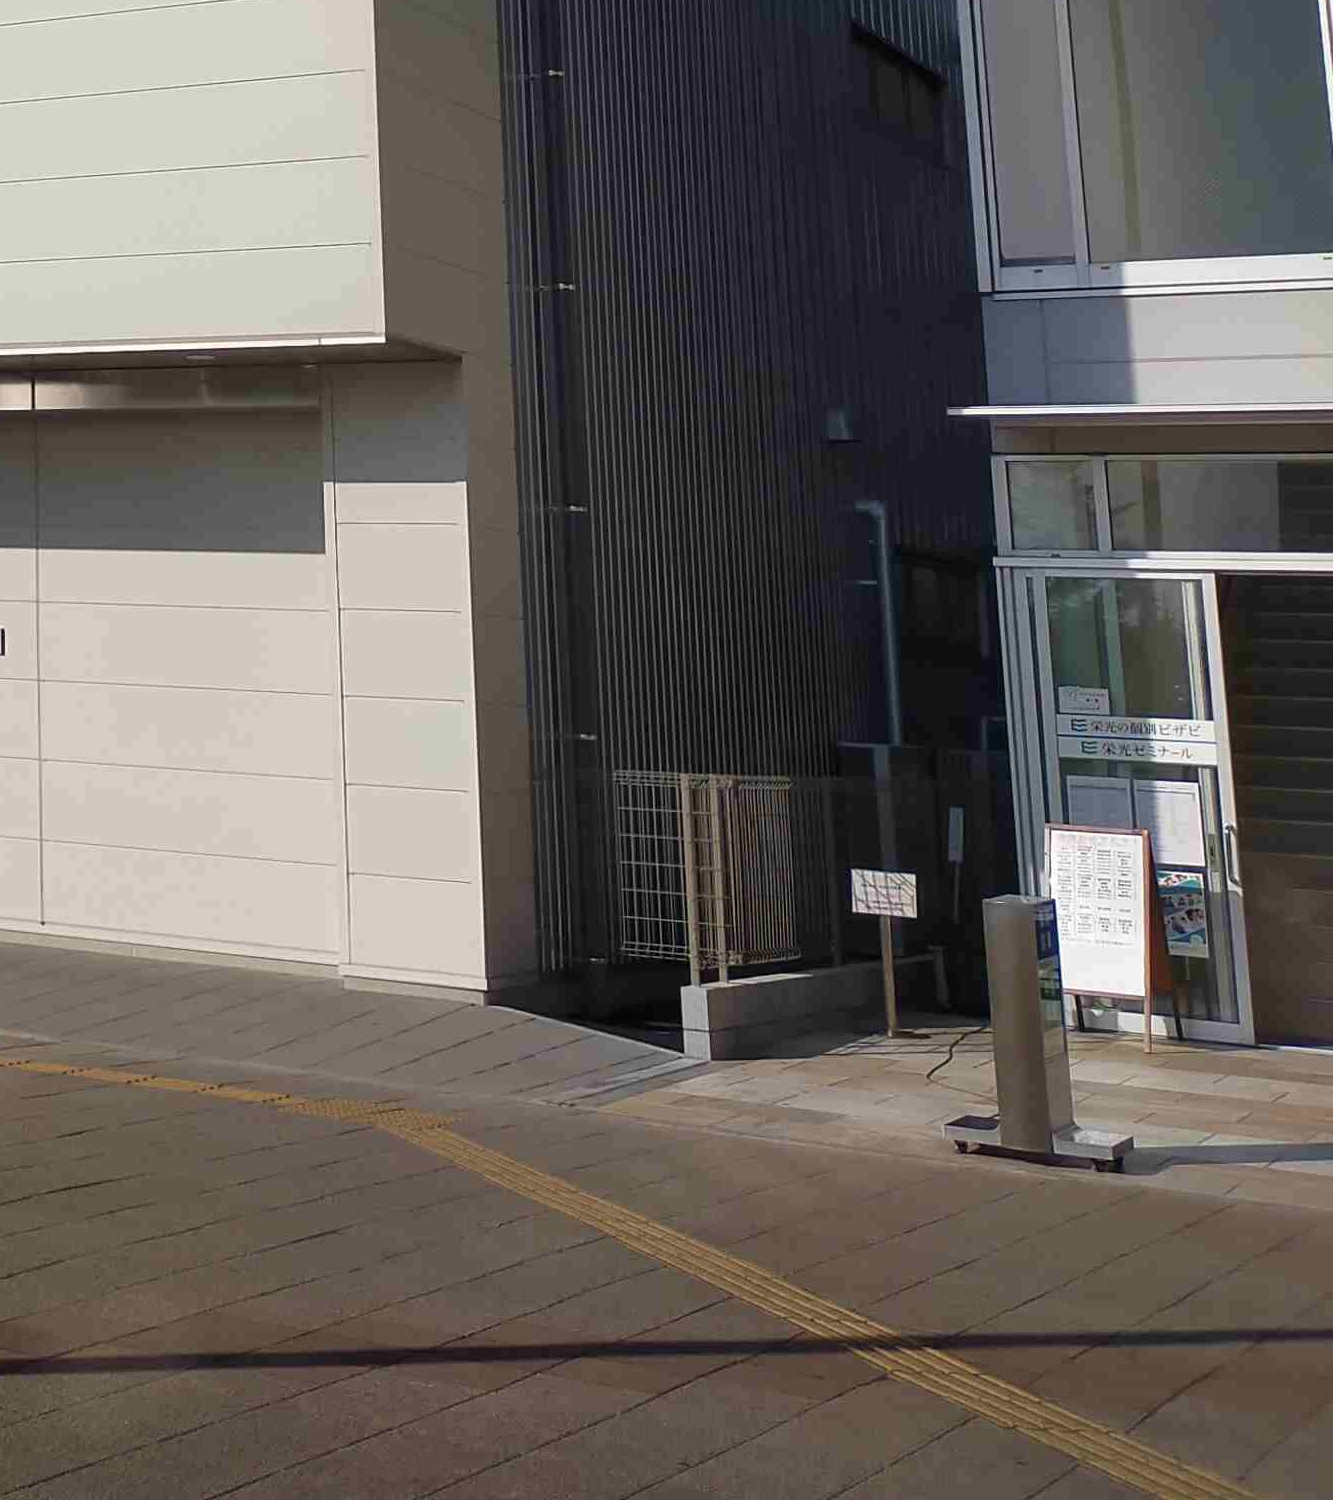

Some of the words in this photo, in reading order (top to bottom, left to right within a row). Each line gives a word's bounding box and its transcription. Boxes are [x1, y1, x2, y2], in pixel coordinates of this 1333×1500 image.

[1101, 740, 1193, 760] 栄光ゼミナール
